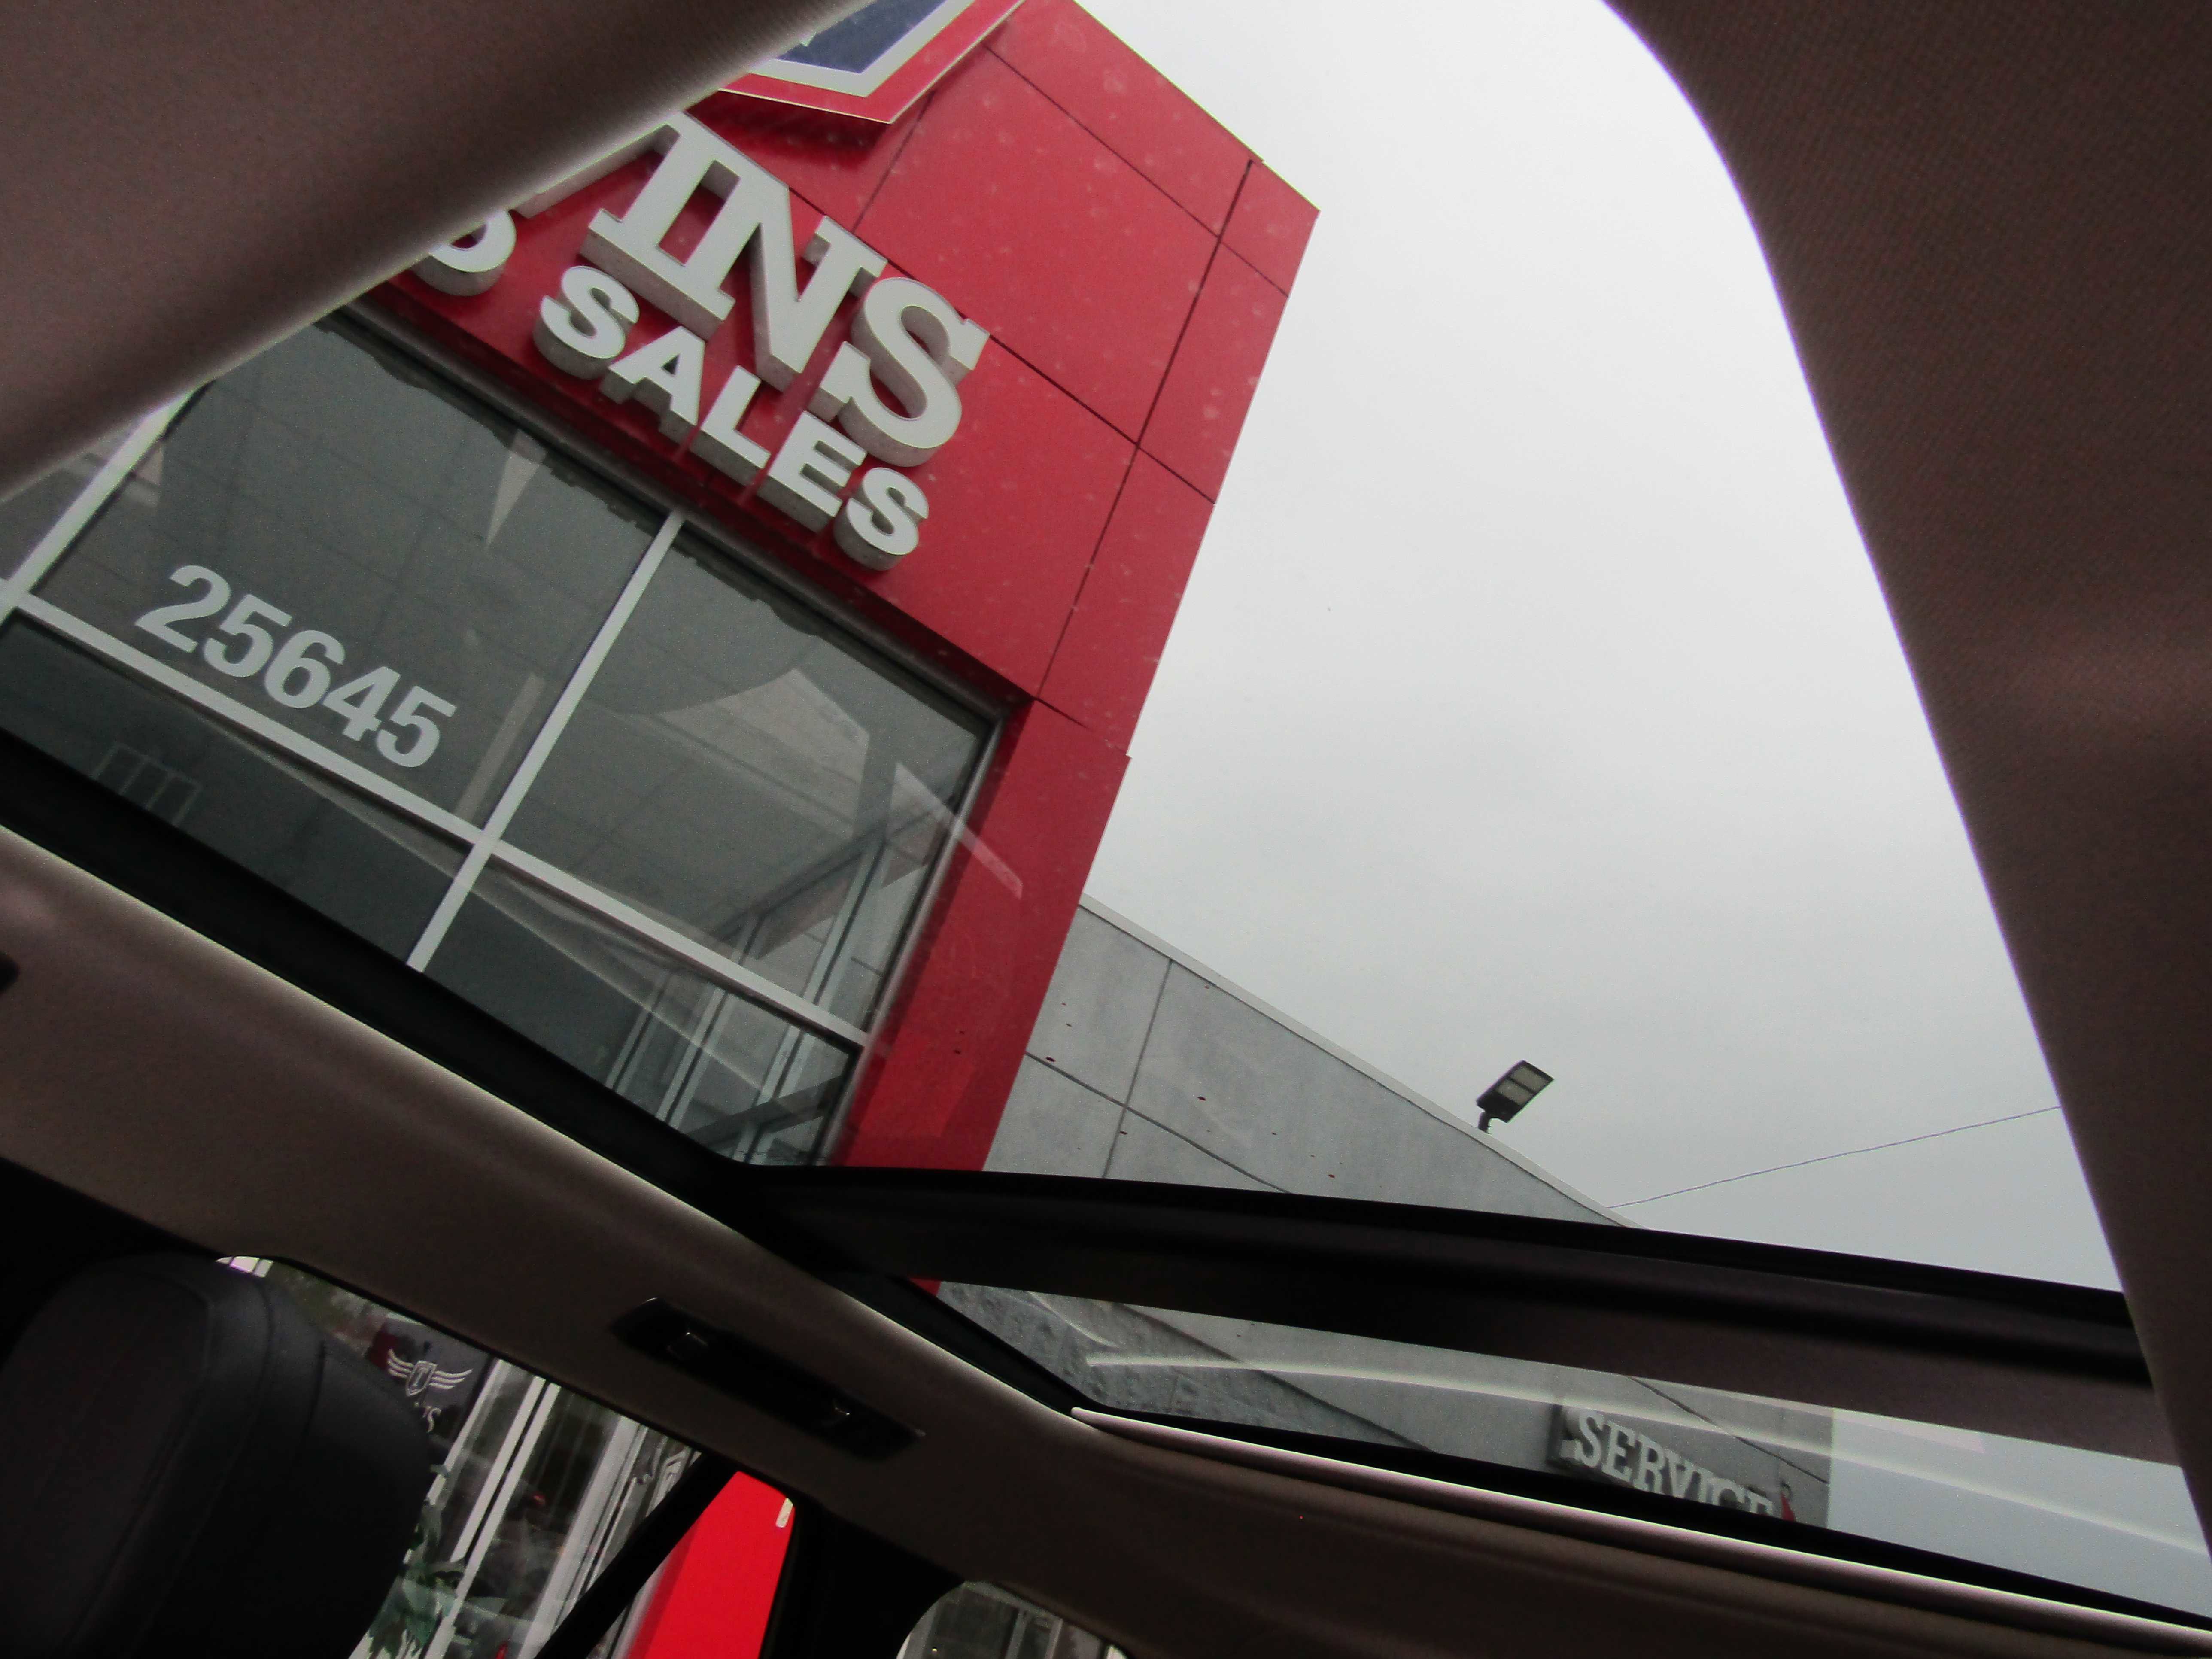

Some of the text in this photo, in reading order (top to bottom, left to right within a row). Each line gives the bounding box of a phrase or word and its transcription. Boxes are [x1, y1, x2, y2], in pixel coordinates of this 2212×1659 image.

[513, 113, 990, 466] INS
[533, 266, 929, 570] SALES
[135, 565, 456, 767] 25645
